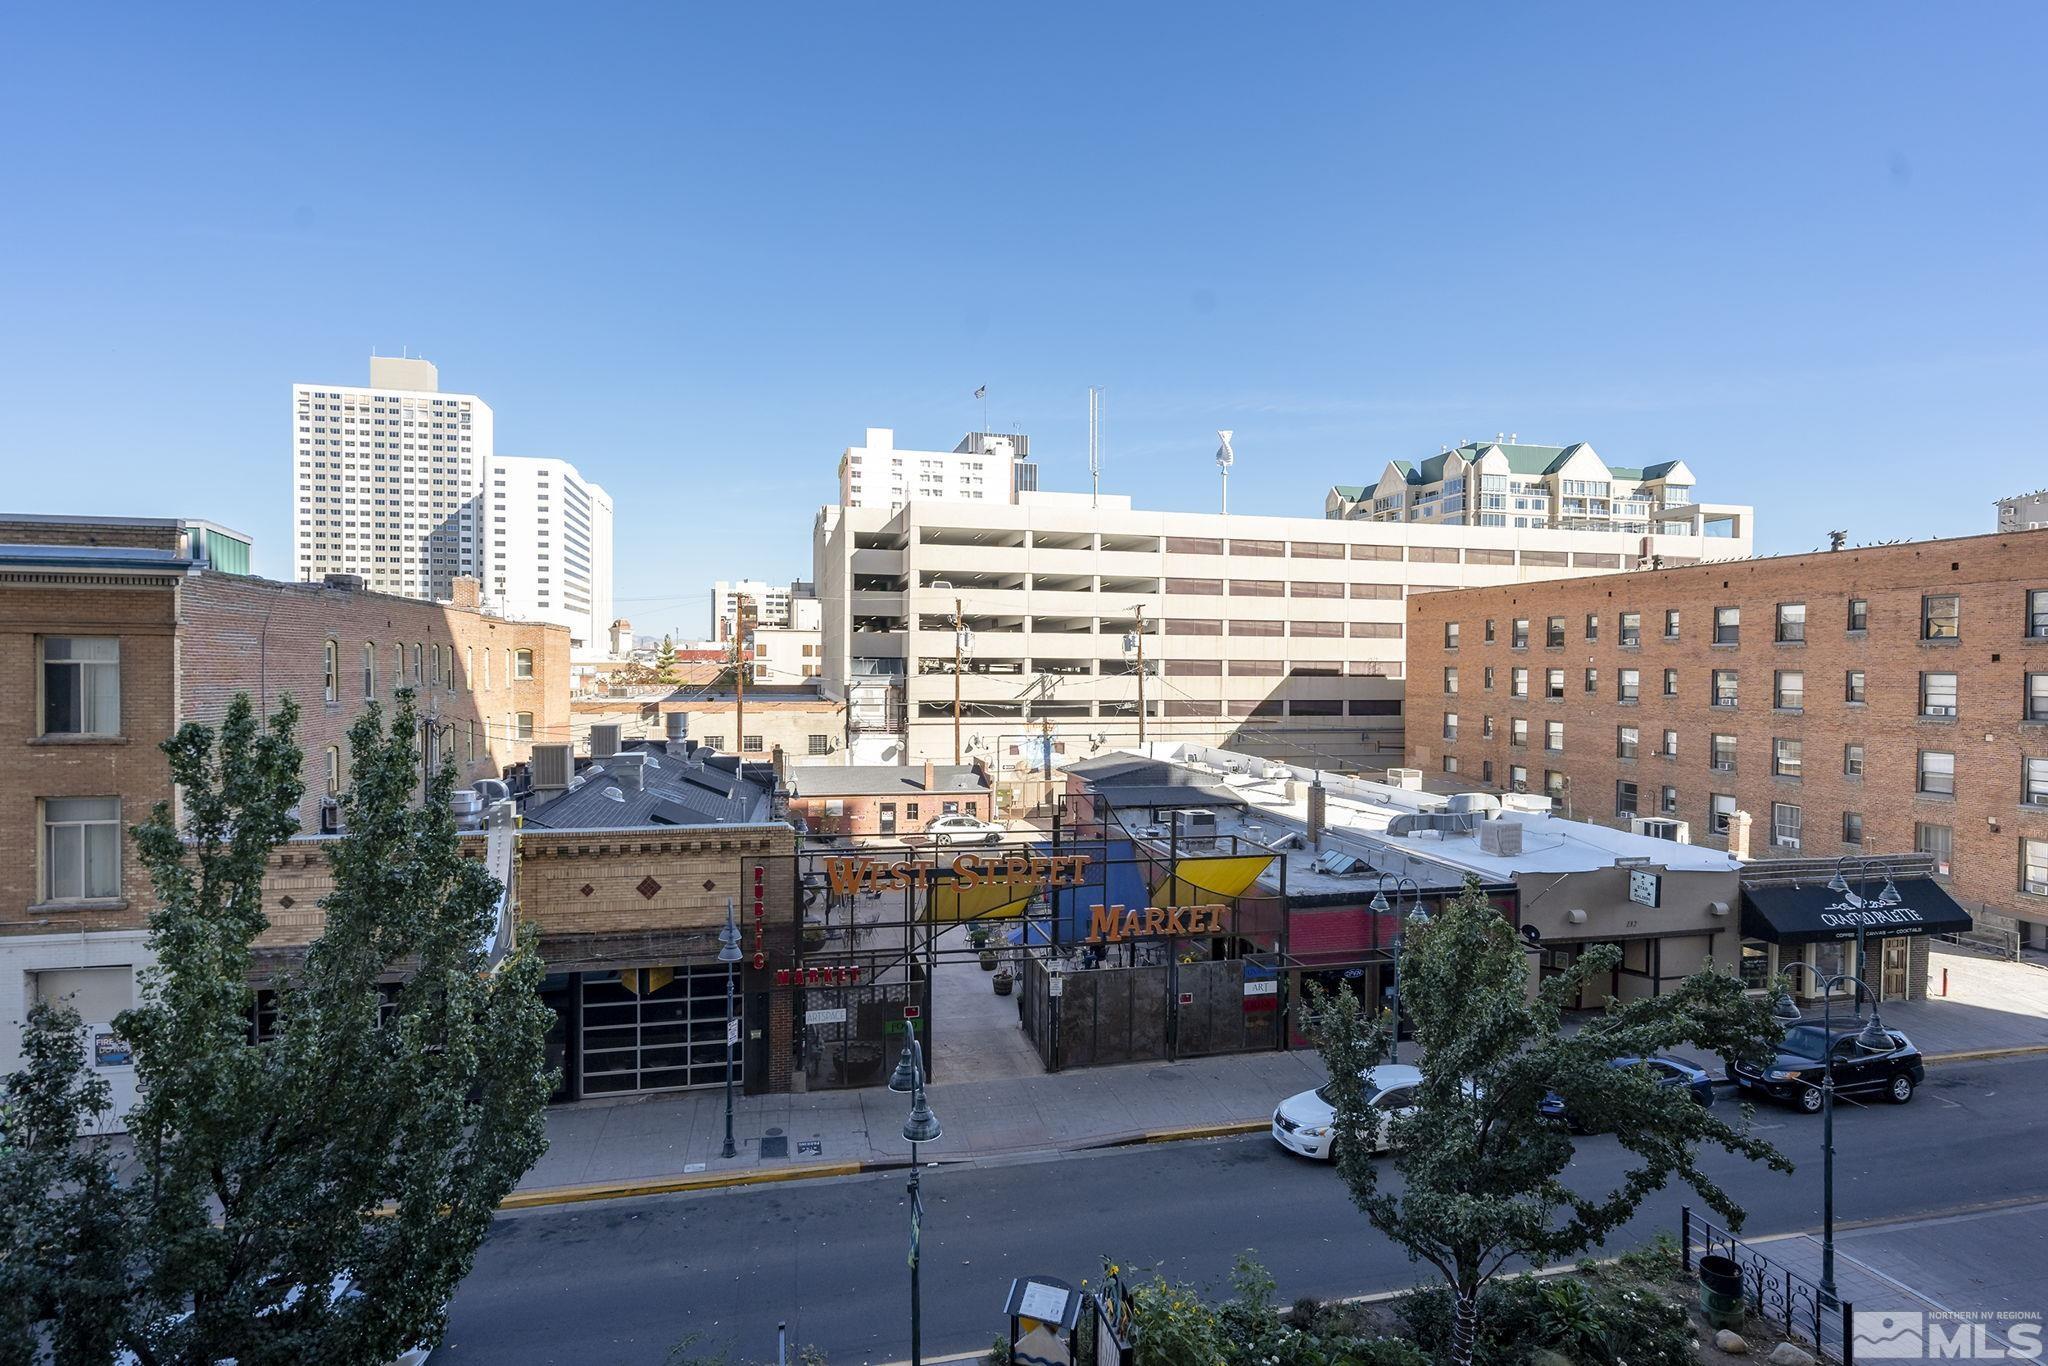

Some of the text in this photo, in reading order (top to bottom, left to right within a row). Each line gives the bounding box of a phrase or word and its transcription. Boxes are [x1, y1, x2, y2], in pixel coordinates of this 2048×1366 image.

[823, 854, 1091, 895] WEST STREET
[754, 866, 765, 969] PUBLIC
[1085, 904, 1227, 942] MARKET
[1871, 909, 1923, 923] PALETTE
[777, 965, 860, 985] MARKET
[1252, 983, 1269, 993] ART
[806, 1010, 845, 1023] ARTSPACE
